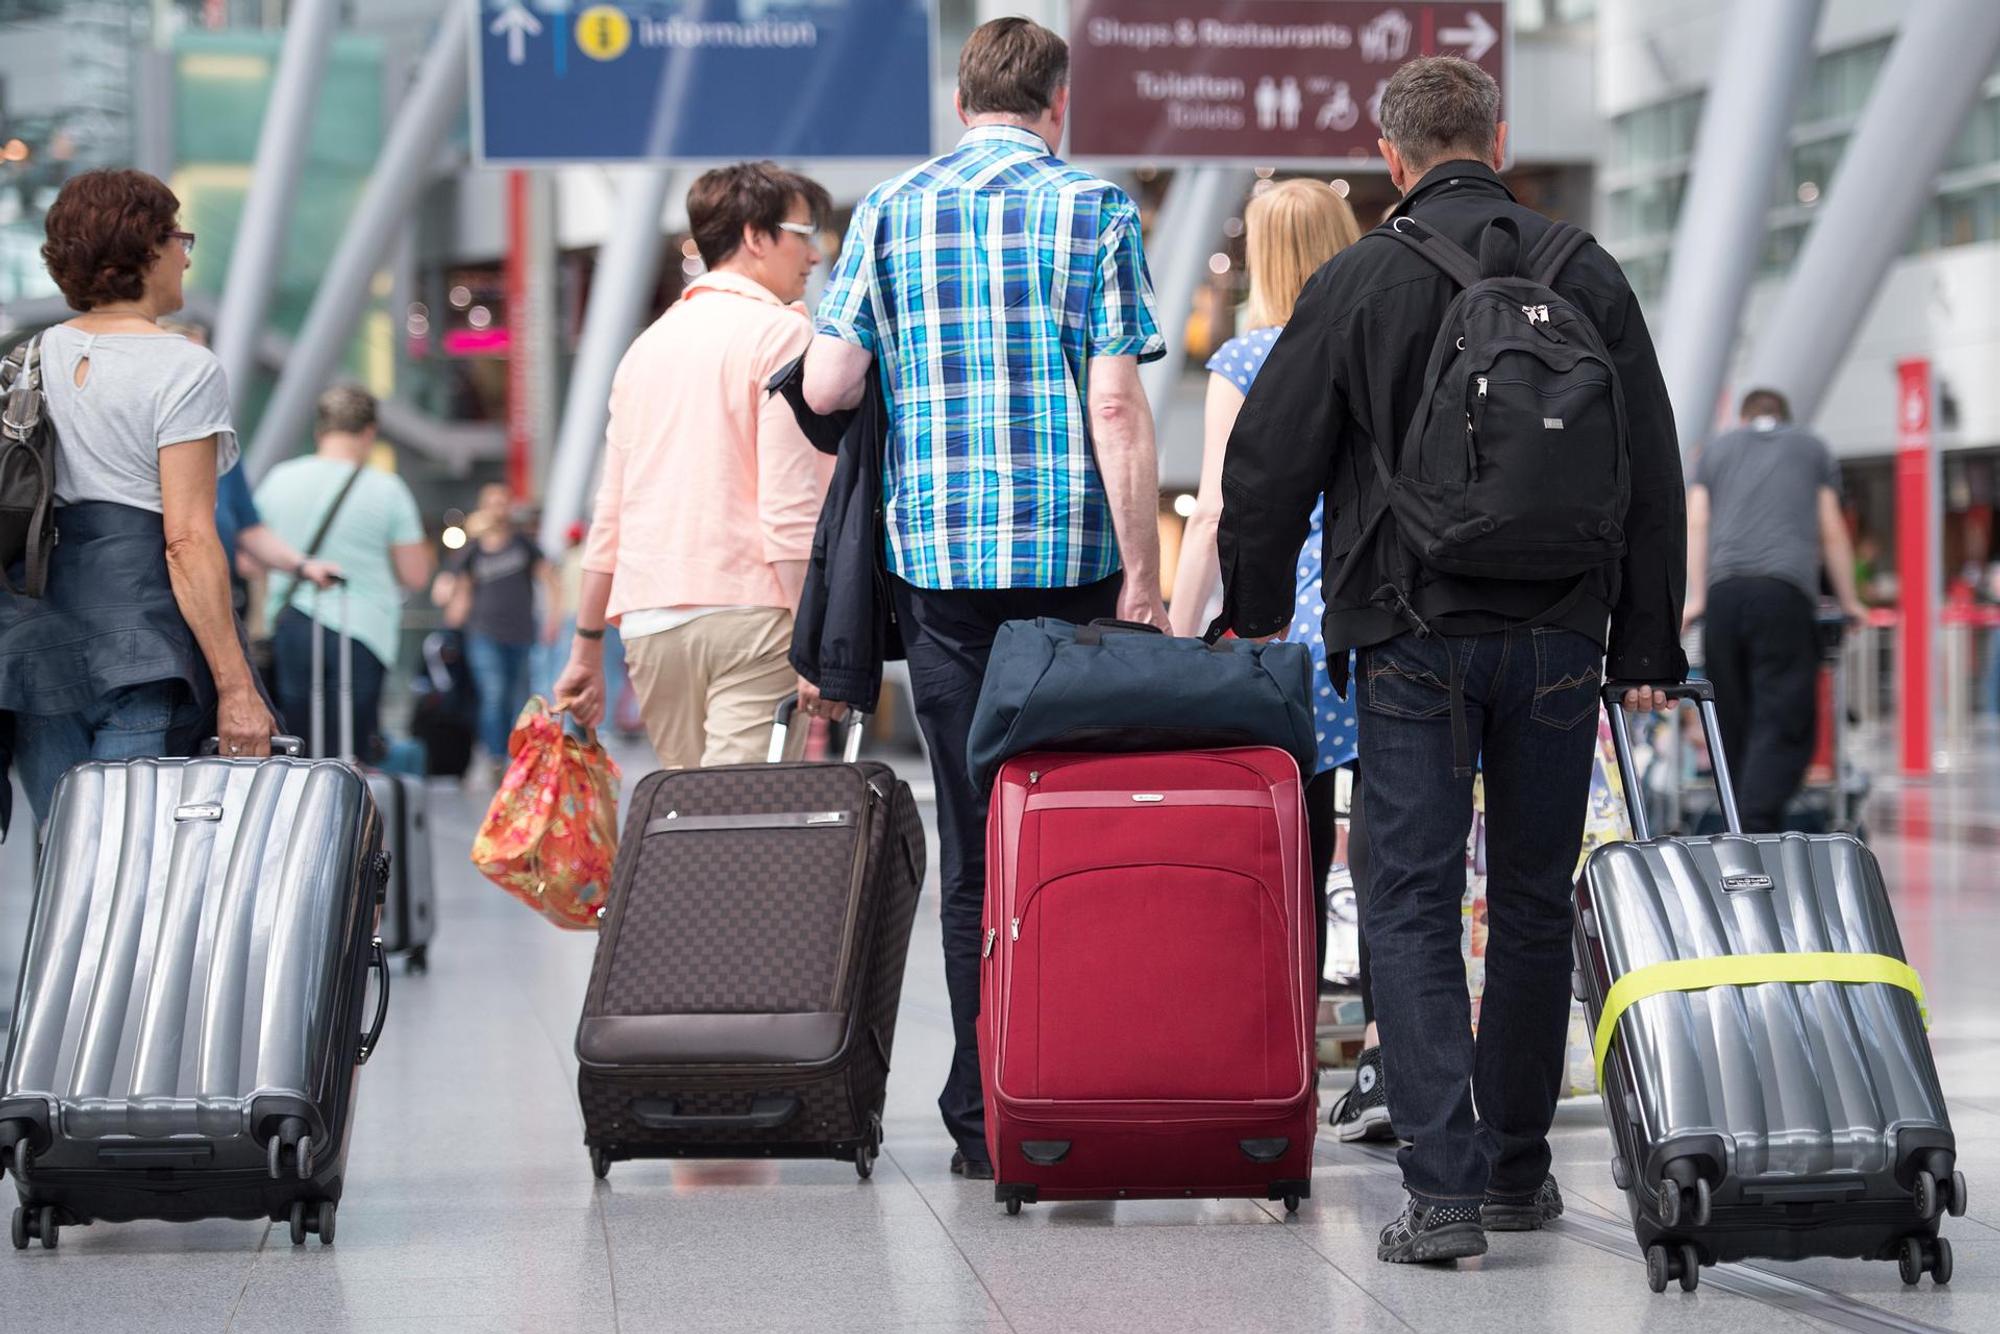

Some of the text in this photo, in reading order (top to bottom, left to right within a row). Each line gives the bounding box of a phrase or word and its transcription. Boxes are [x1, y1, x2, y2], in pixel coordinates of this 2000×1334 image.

[639, 16, 817, 47] Information
[1089, 18, 1352, 50] Shops & Restaurants
[1136, 70, 1245, 99] Toiletten
[1167, 101, 1245, 130] Toilets
